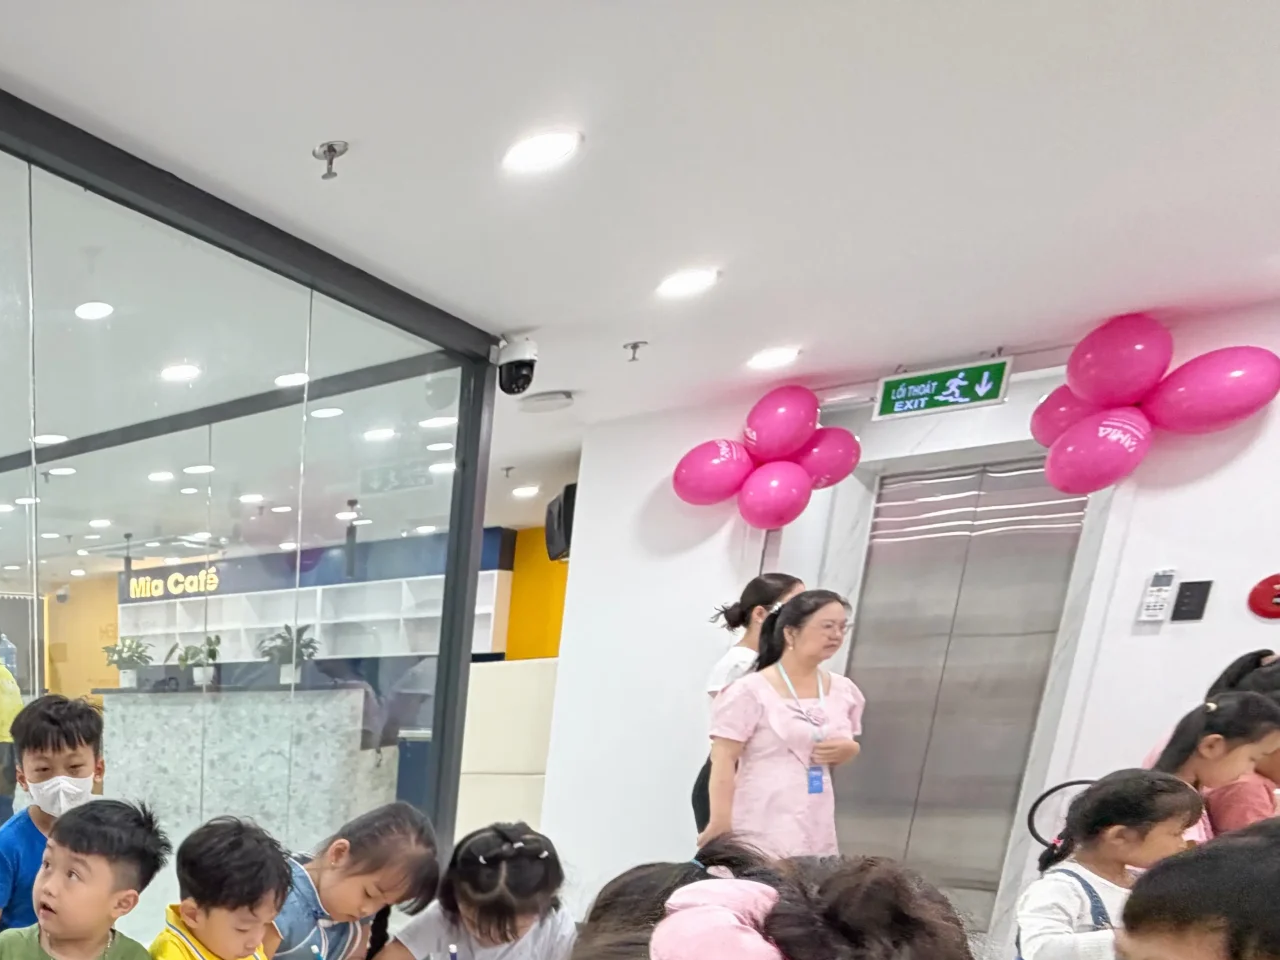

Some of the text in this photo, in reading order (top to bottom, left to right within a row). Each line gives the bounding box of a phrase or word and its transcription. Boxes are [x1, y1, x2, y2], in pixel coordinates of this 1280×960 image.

[893, 397, 928, 412] EXIT
[129, 566, 219, 598] Mia Café
